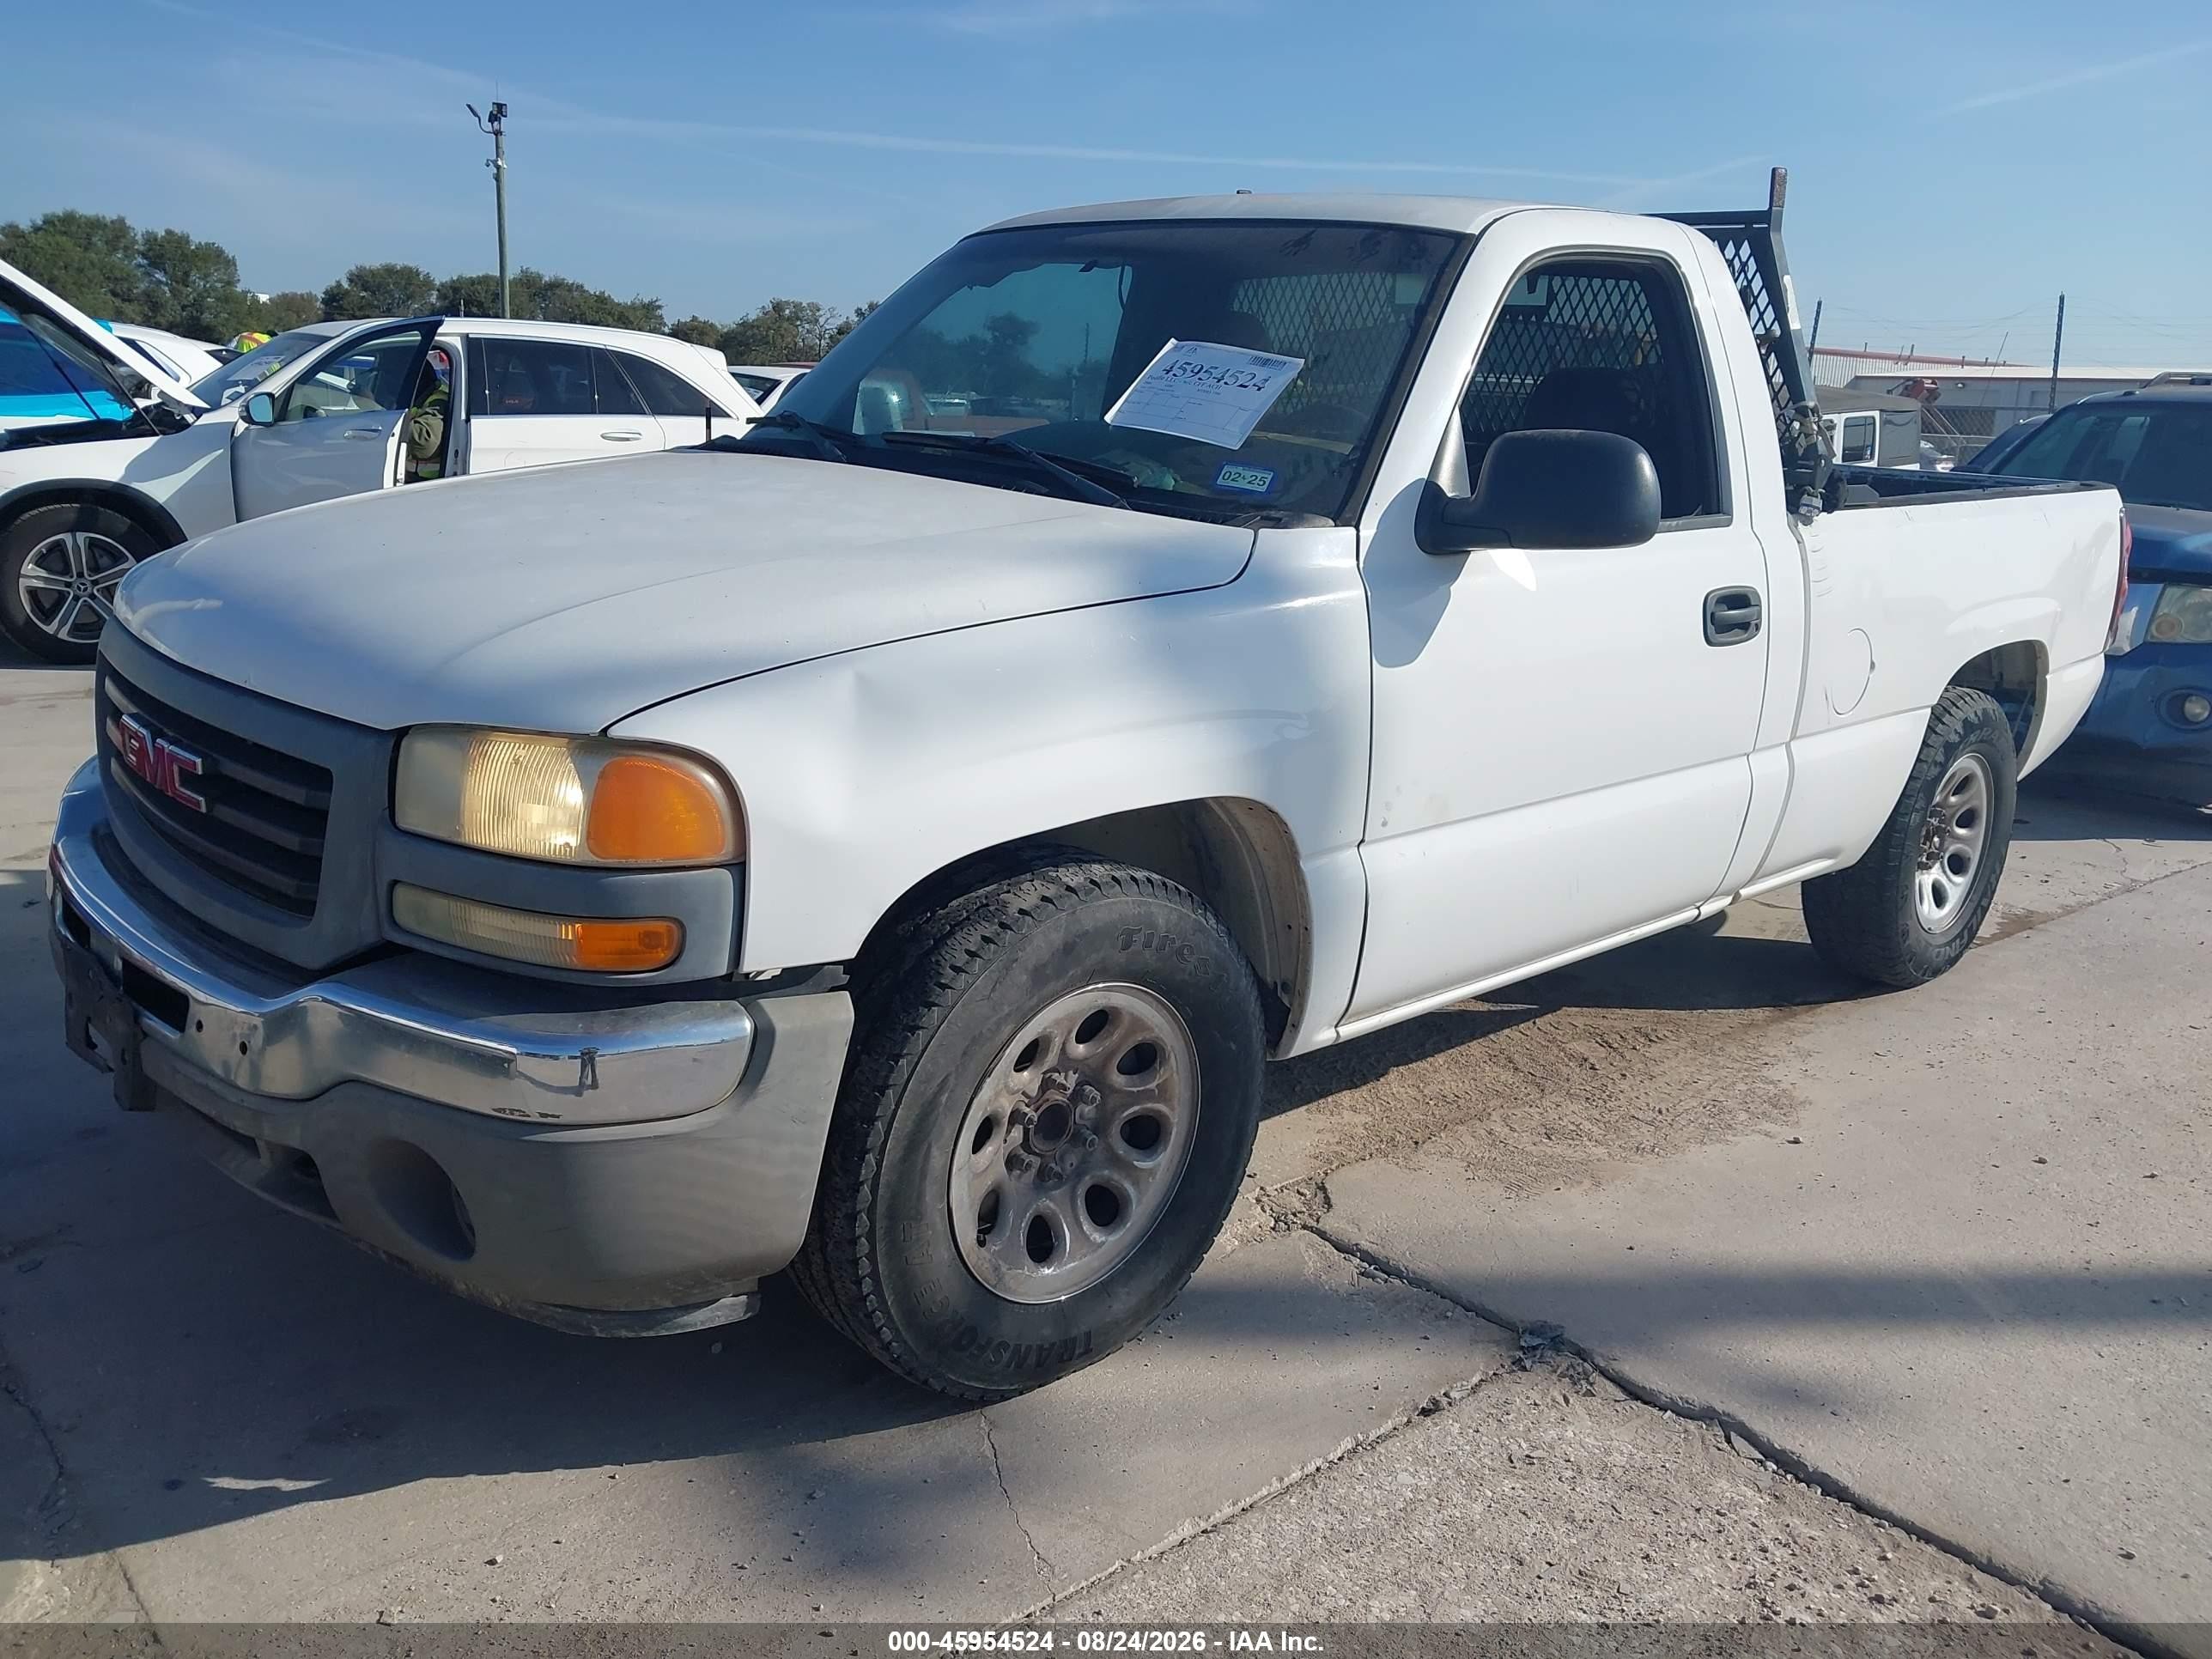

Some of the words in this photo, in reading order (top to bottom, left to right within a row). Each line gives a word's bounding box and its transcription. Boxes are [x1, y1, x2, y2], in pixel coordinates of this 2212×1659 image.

[1162, 360, 1271, 392] 45954524
[1222, 470, 1242, 483] 02
[1246, 474, 1268, 487] 25
